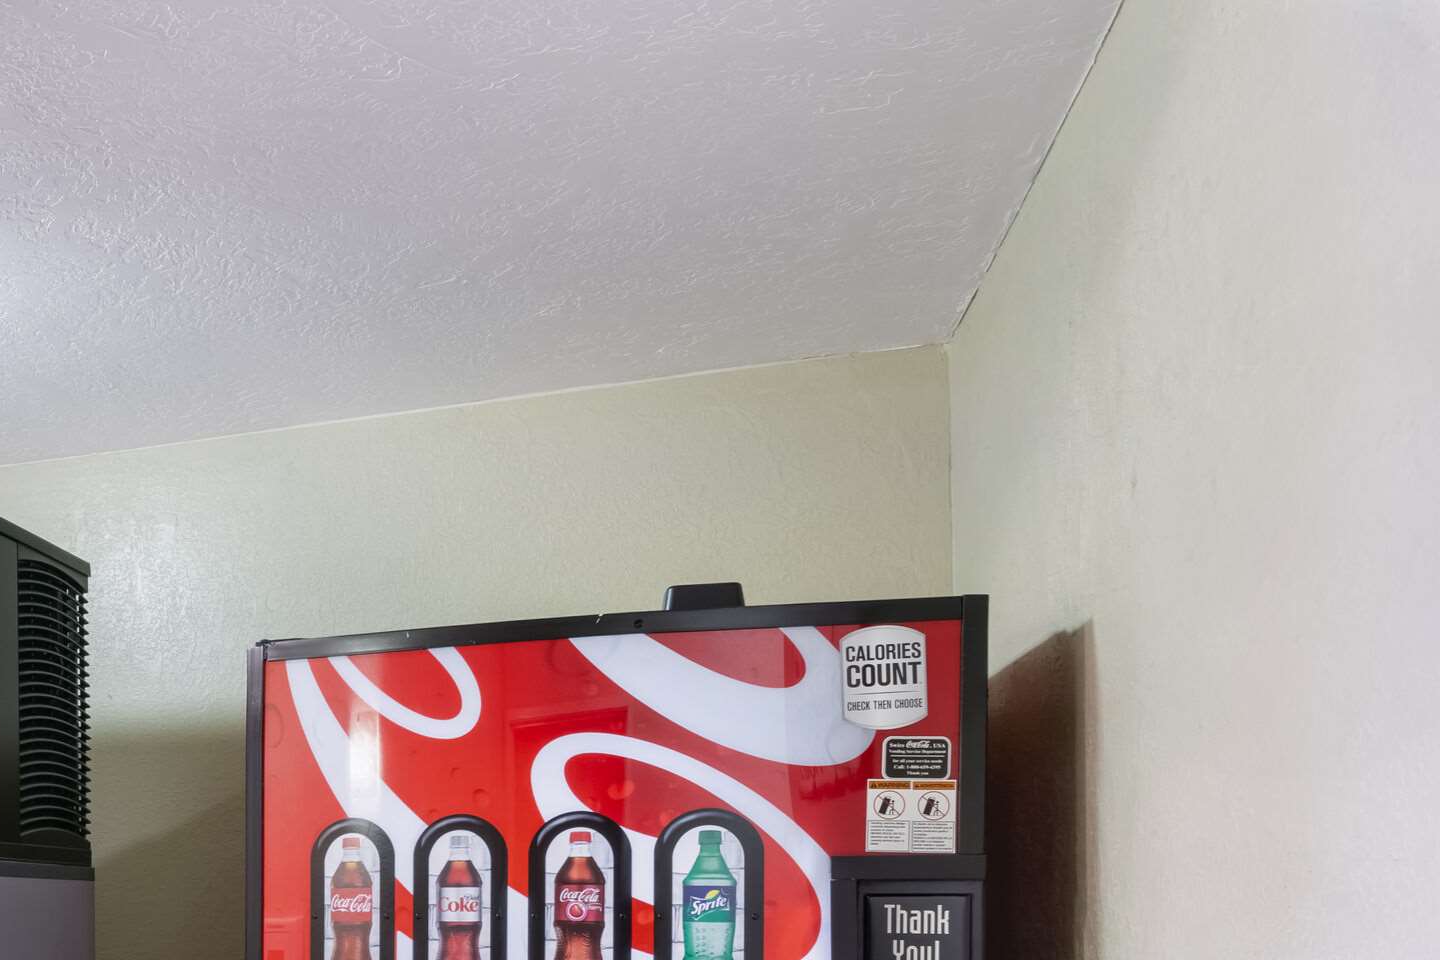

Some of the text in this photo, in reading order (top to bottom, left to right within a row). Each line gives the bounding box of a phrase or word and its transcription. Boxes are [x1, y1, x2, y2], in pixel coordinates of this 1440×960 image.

[845, 642, 921, 662] CALORIES
[846, 662, 921, 688] COUNT
[847, 698, 923, 712] CHECK THEN CHOOSE
[331, 894, 372, 912] Coca-Cola
[438, 896, 479, 912] Coke
[560, 888, 600, 902] Coca-Cola
[691, 897, 727, 915] Sprite
[884, 904, 950, 935] Thank
